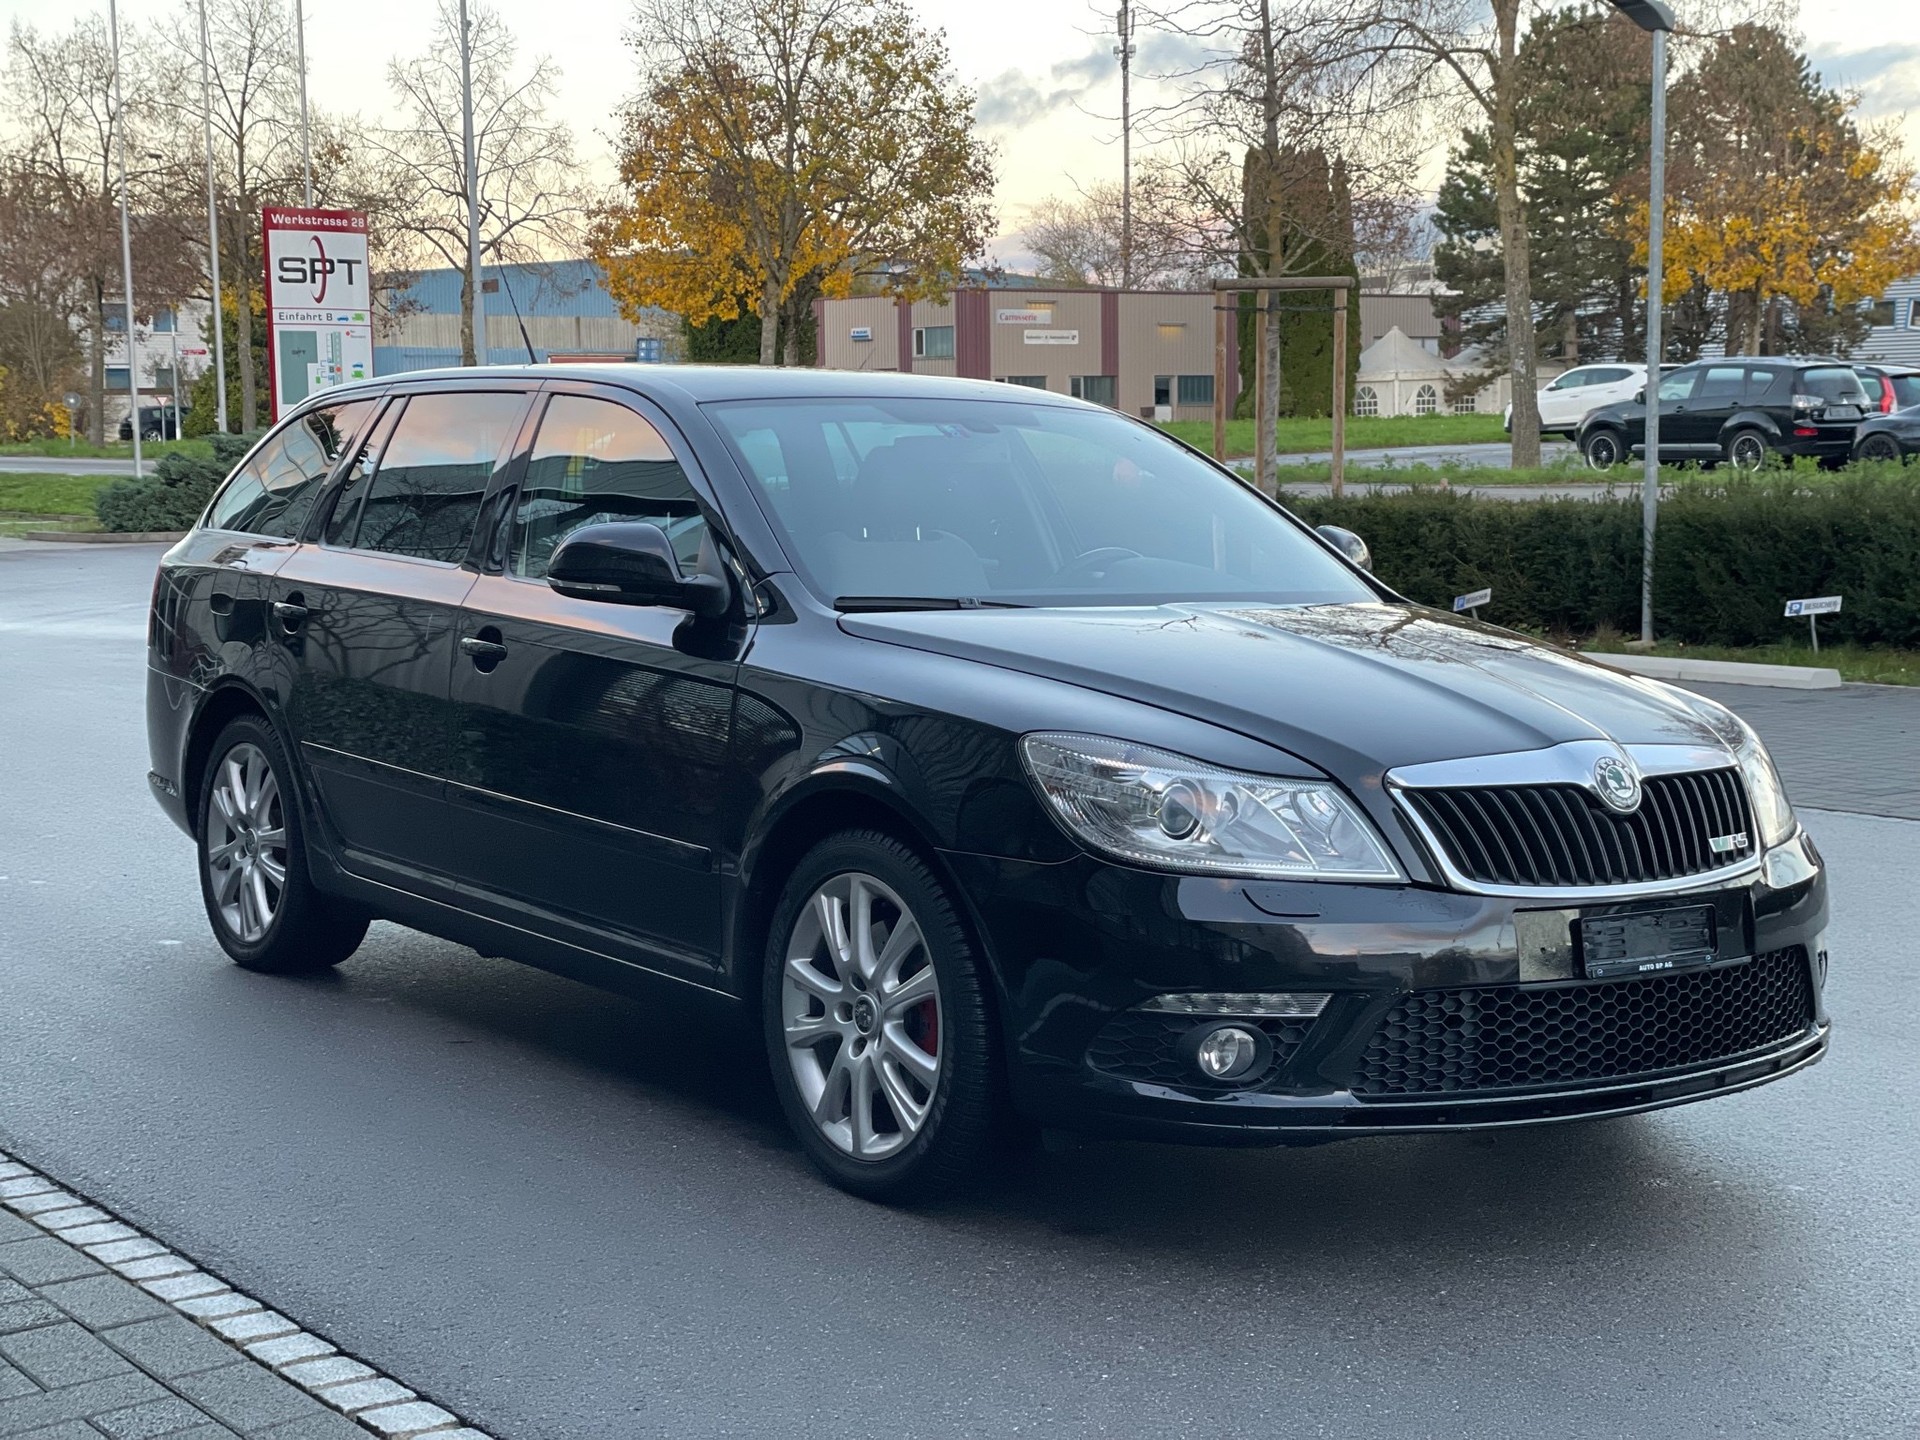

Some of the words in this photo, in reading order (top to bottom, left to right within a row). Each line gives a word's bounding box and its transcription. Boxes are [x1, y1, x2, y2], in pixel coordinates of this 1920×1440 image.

[271, 213, 348, 227] Werkstrasse
[351, 217, 365, 228] 28
[278, 257, 362, 286] SPT
[278, 311, 323, 321] Einfahrt
[326, 312, 333, 322] B
[1639, 963, 1655, 971] AUTO
